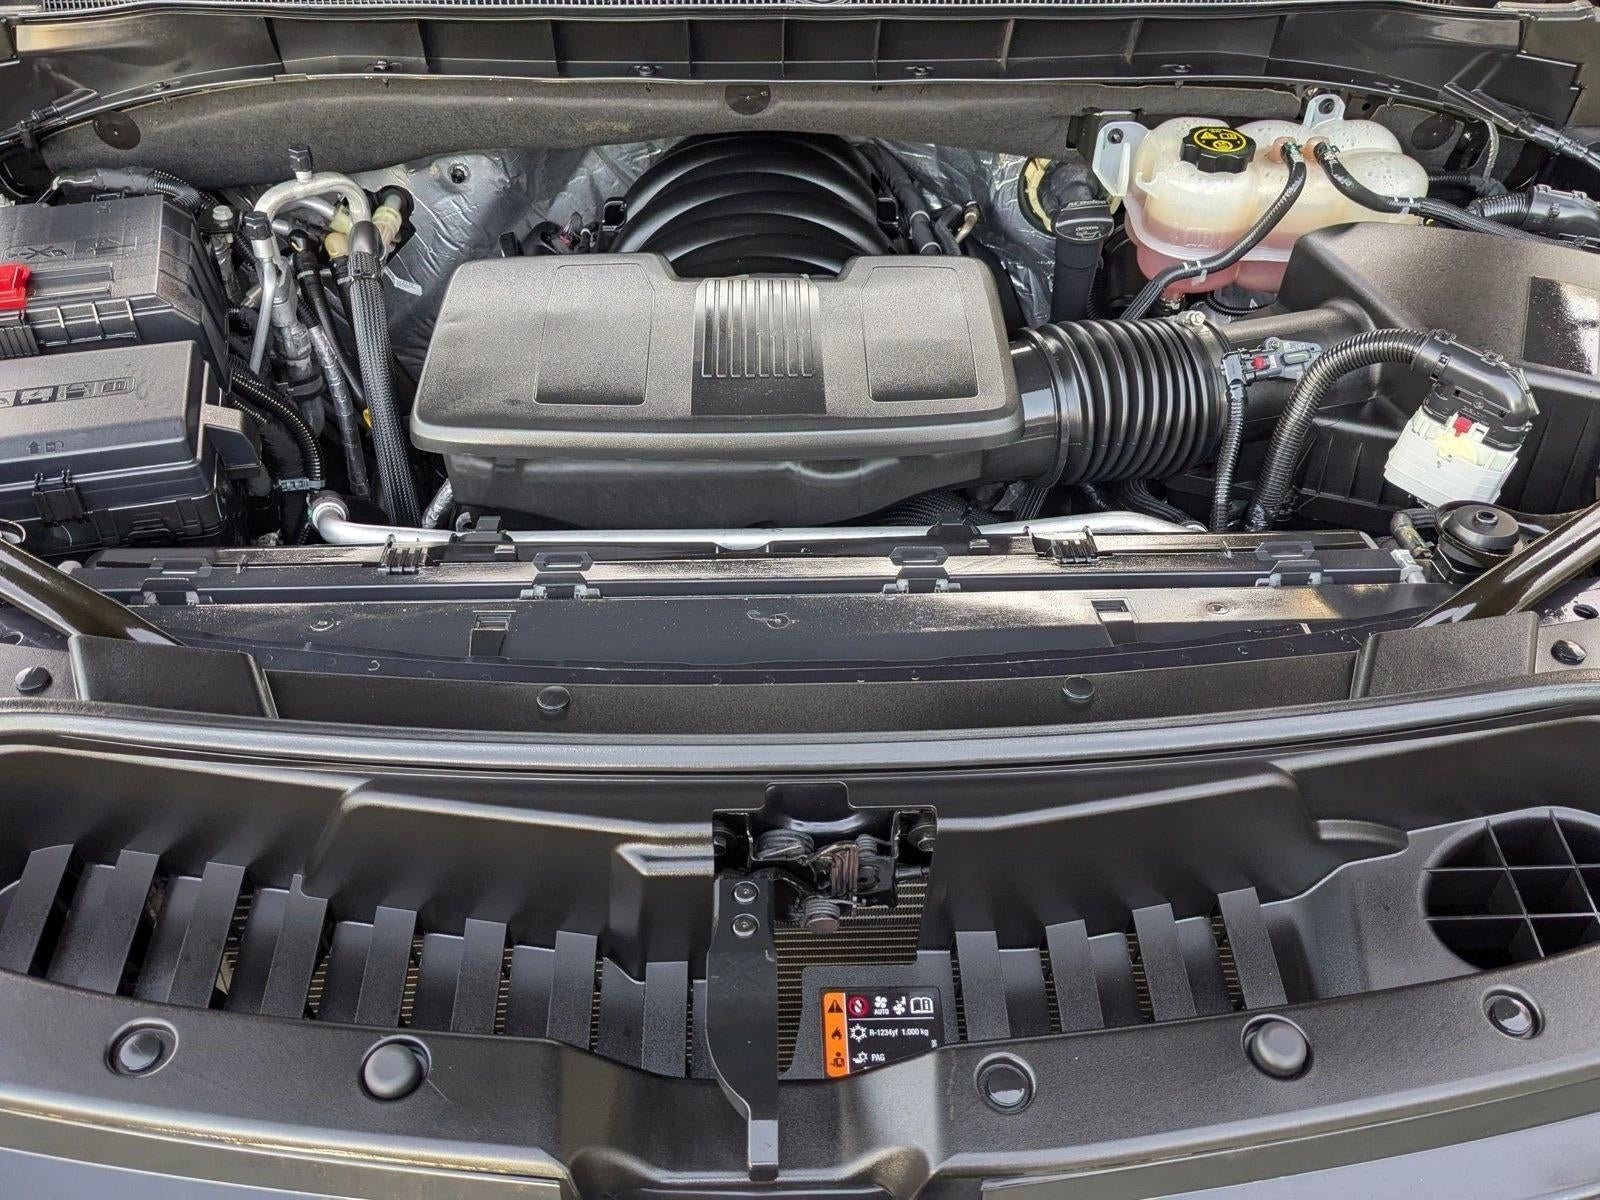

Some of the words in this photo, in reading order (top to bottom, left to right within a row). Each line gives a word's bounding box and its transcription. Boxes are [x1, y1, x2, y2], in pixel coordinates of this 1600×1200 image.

[869, 1028, 898, 1038] R-1234yf
[901, 1028, 919, 1036] 1.000
[920, 1028, 929, 1037] kg
[871, 1053, 886, 1062] PAG
